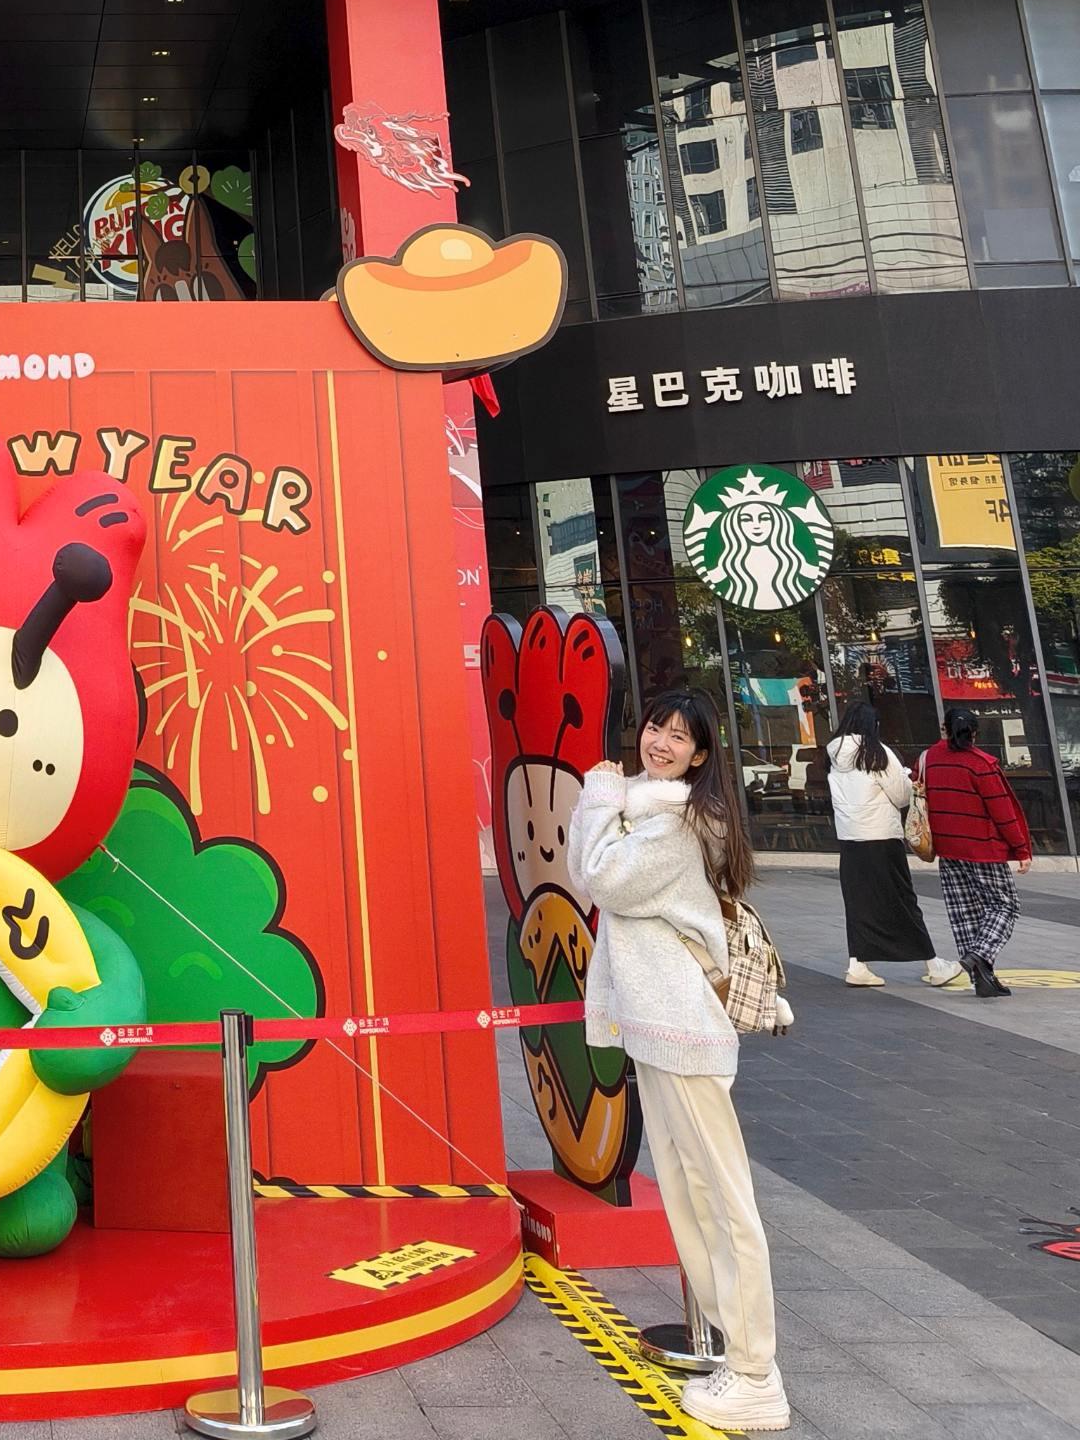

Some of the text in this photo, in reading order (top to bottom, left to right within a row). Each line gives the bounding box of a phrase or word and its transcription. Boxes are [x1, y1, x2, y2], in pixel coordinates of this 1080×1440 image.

[607, 358, 857, 413] 星巴克咖啡
[97, 427, 313, 535] YEAR
